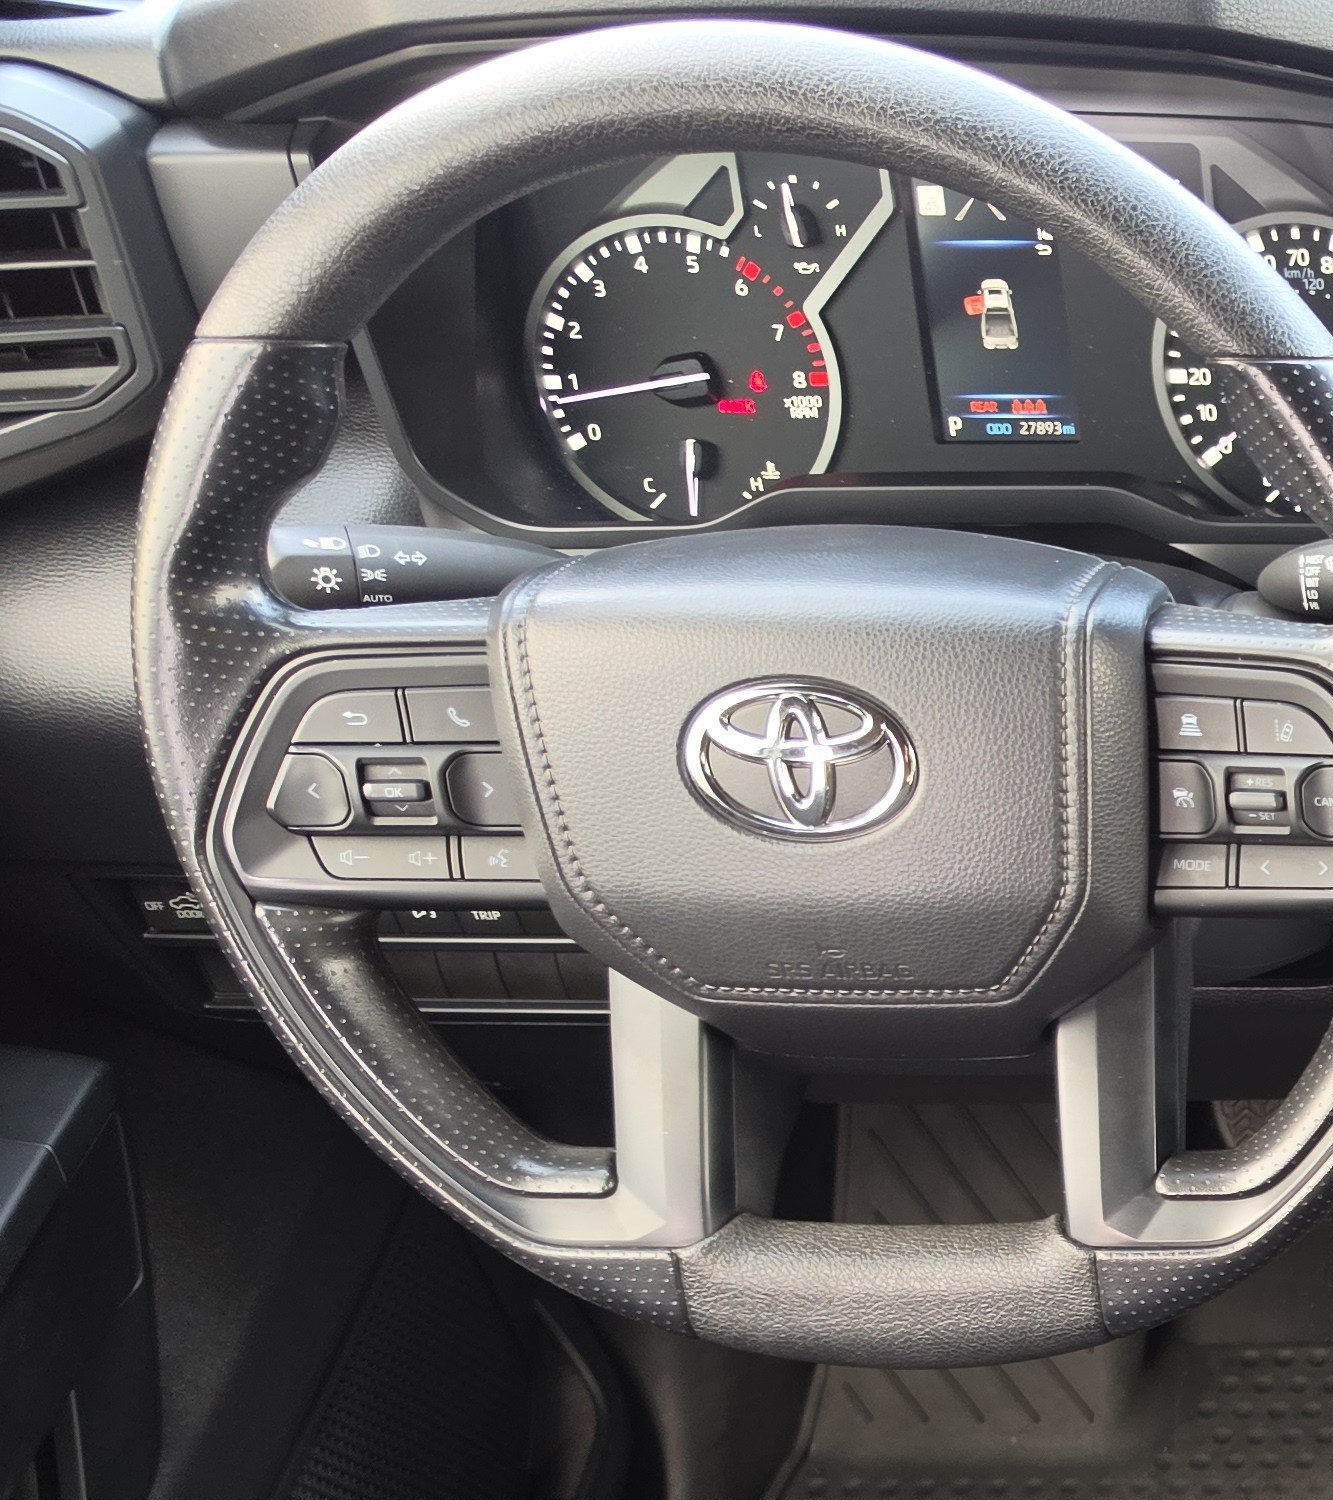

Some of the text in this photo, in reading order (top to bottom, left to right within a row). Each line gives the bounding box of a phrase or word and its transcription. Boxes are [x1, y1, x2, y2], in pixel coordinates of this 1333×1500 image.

[835, 224, 847, 237] H
[633, 257, 649, 274] 4
[686, 257, 700, 274] 5
[1285, 248, 1310, 267] 70
[1283, 267, 1315, 279] km/h
[593, 280, 607, 297] 3
[734, 279, 749, 296] 6
[1302, 278, 1325, 291] 120
[568, 322, 583, 340] 2
[771, 323, 785, 341] 7
[568, 373, 578, 390] 1
[792, 370, 807, 389] 8
[1188, 368, 1212, 386] 20
[1196, 404, 1217, 422] 10
[588, 423, 602, 441] 0
[948, 416, 963, 437] P
[642, 478, 655, 493] C
[749, 476, 764, 492] H
[362, 594, 393, 604] AUTO
[384, 787, 405, 798] OK
[1173, 858, 1213, 872] MODE
